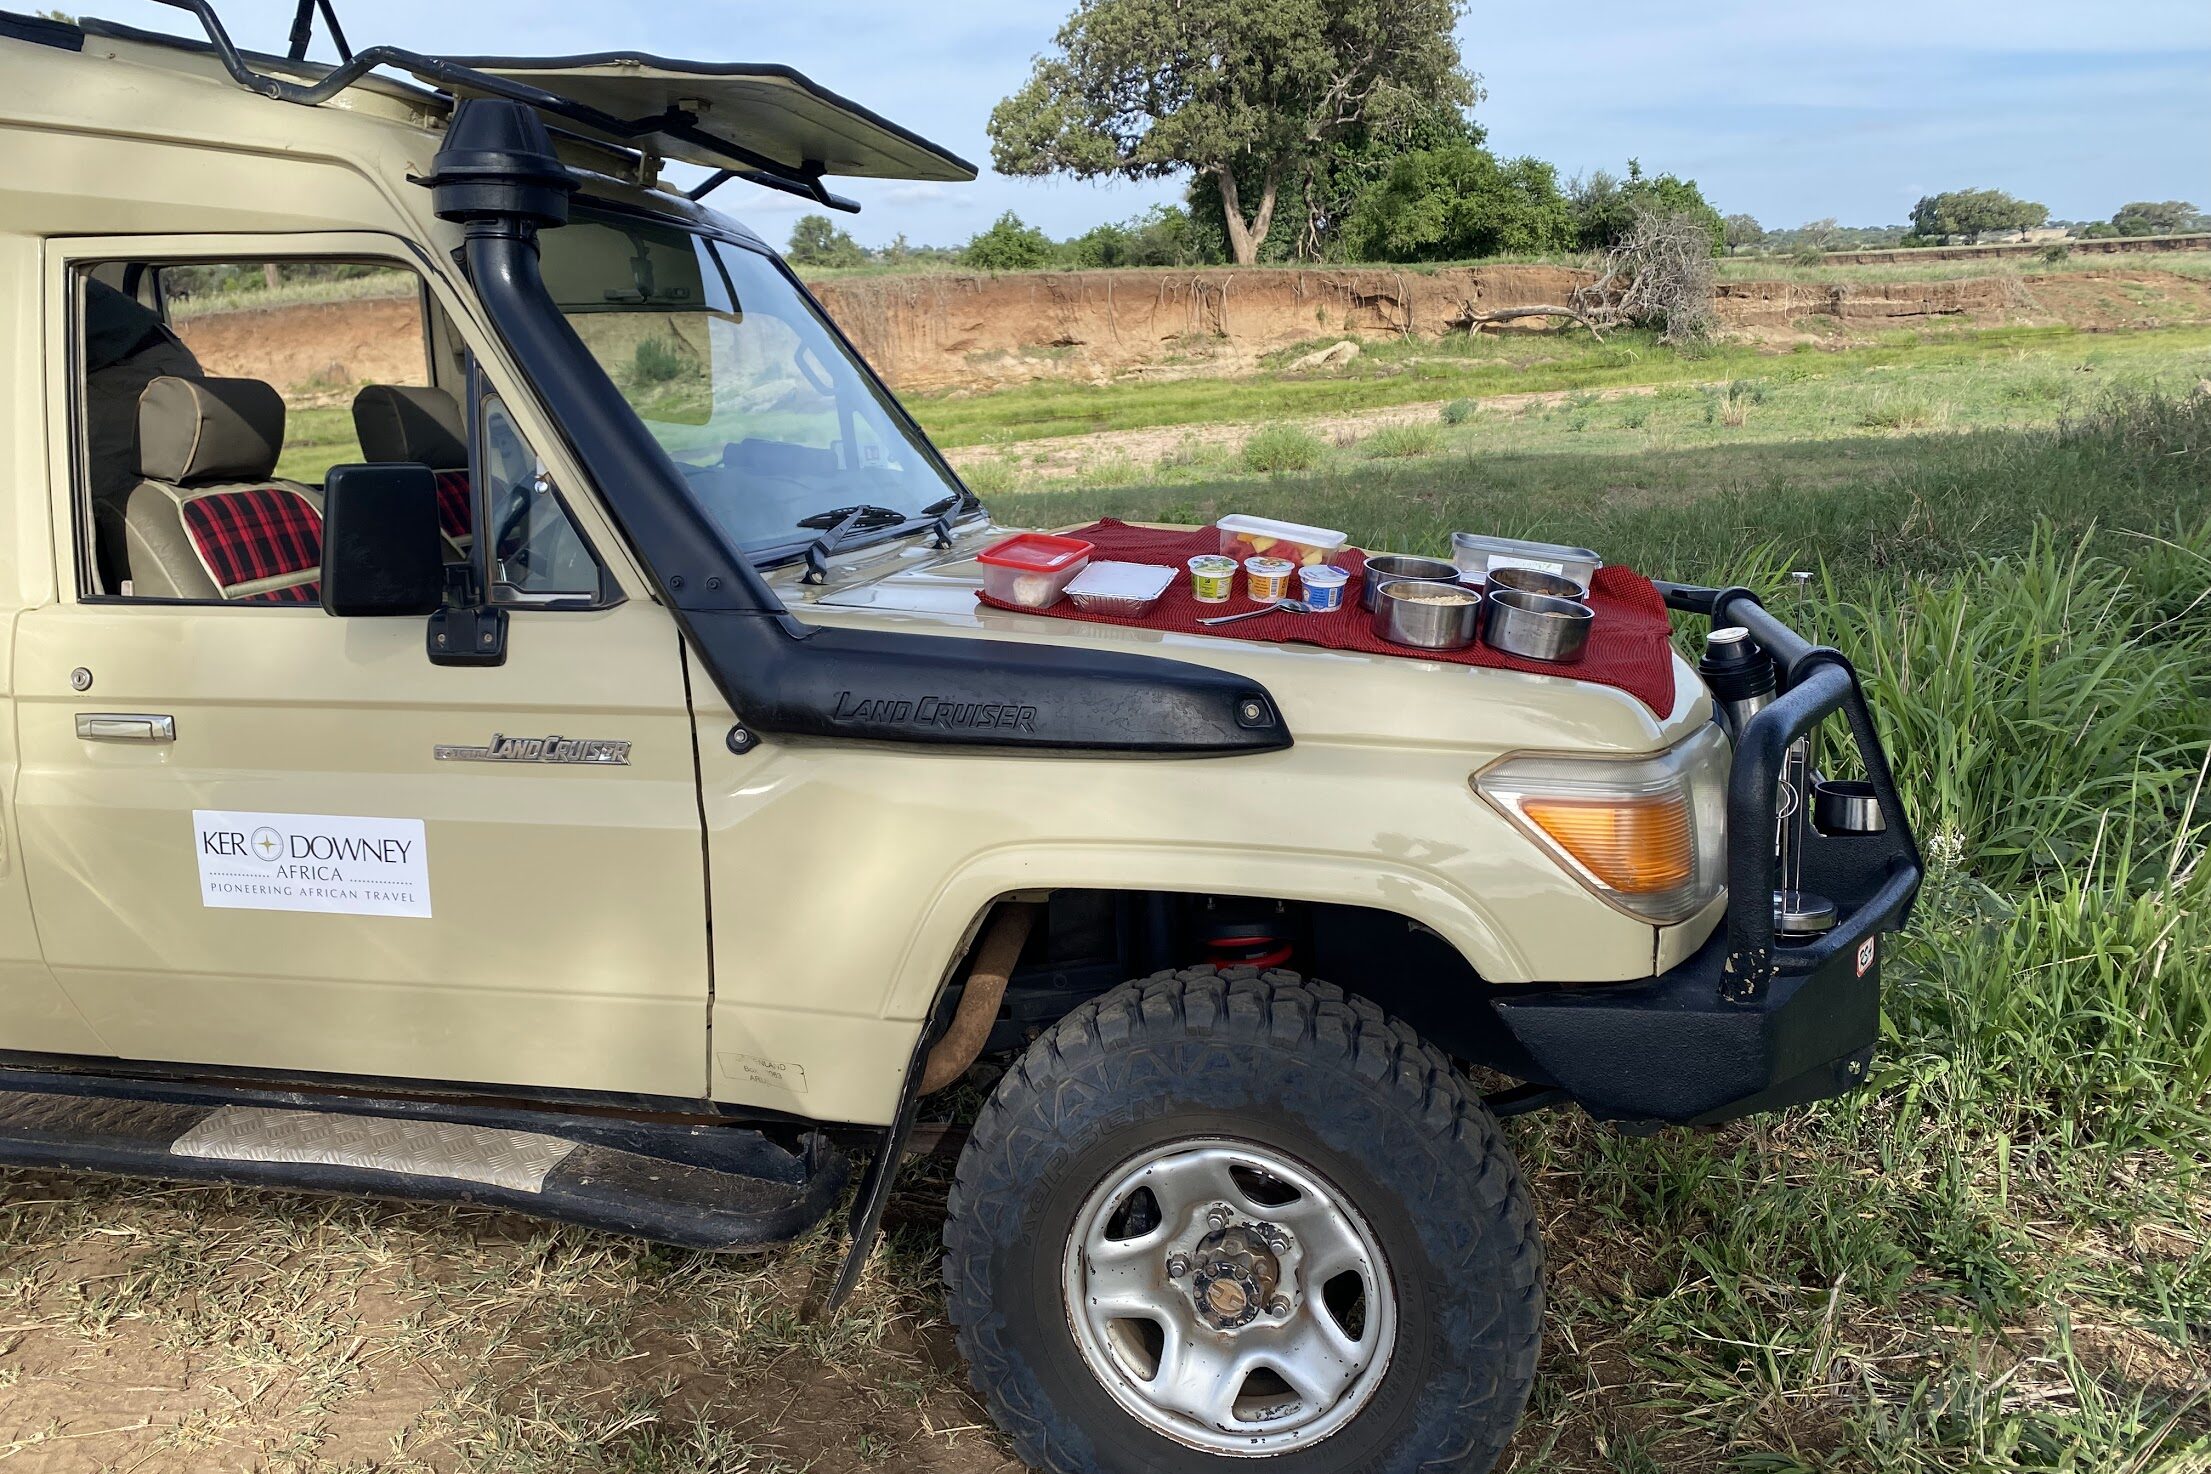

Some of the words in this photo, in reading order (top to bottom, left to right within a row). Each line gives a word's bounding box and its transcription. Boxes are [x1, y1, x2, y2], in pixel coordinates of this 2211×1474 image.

[834, 691, 913, 724] LAND
[914, 696, 1038, 734] CRUISER
[203, 831, 248, 856] KER
[290, 834, 412, 864] DOWNEY
[276, 865, 343, 882] AFRICA
[210, 882, 292, 896] PIONEERING
[299, 888, 358, 899] AFRICAN
[366, 891, 415, 903] TRAVEL
